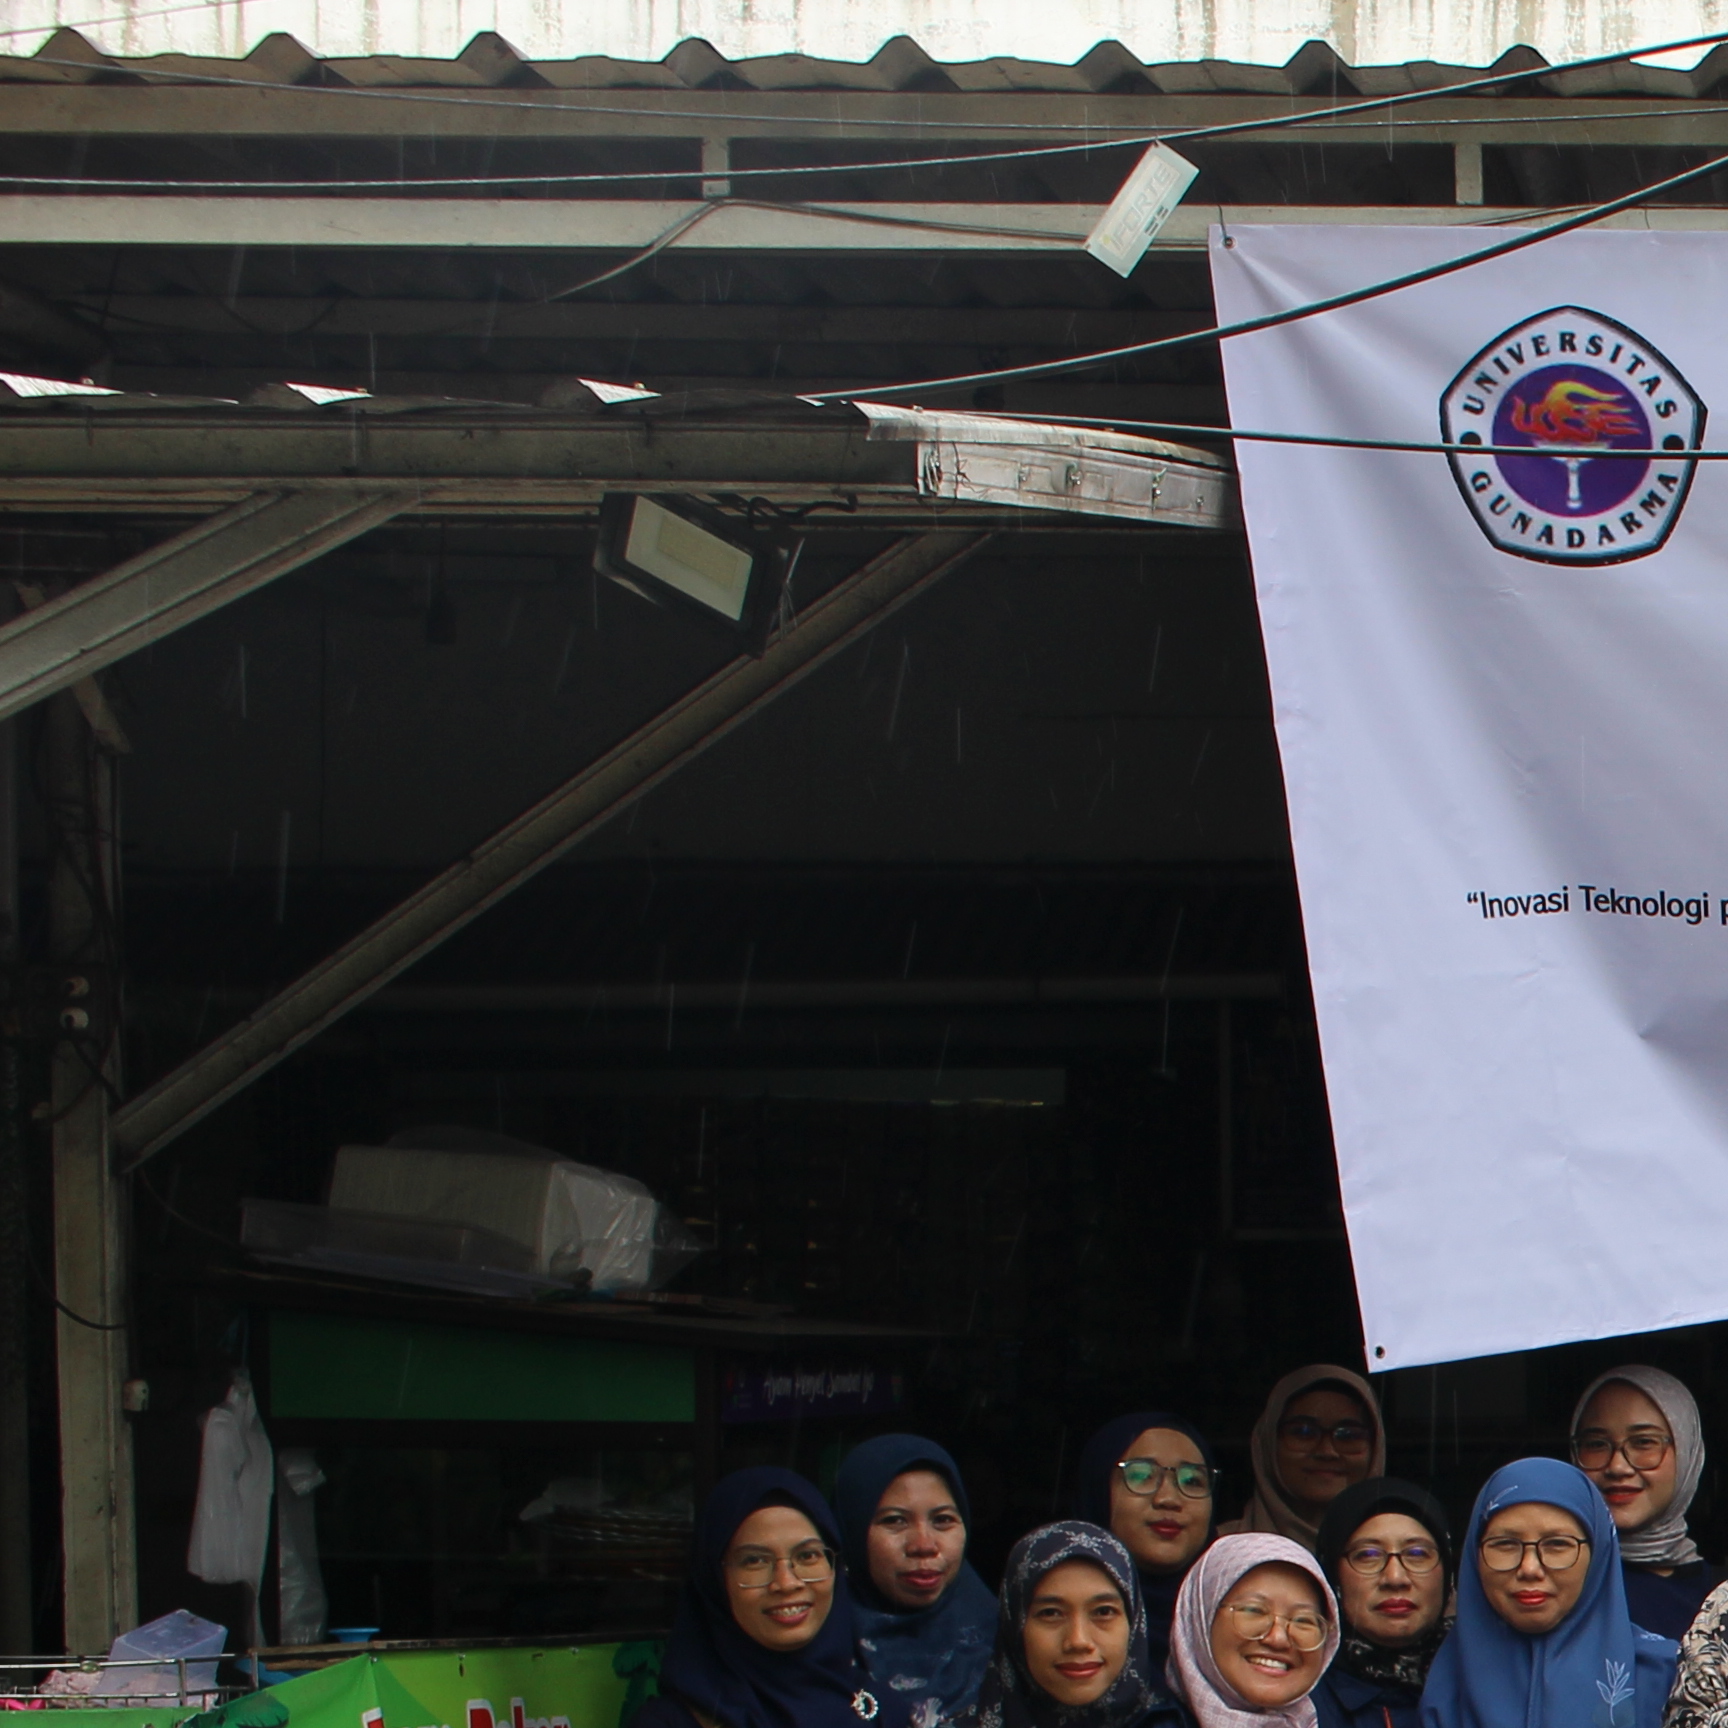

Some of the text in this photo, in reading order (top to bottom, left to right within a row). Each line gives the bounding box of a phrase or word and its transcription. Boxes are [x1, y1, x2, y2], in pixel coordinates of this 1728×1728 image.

[1463, 331, 1678, 419] UNIVERSITAS
[1471, 471, 1679, 548] GUNADARMA
[1577, 884, 1710, 926] Teknologi
